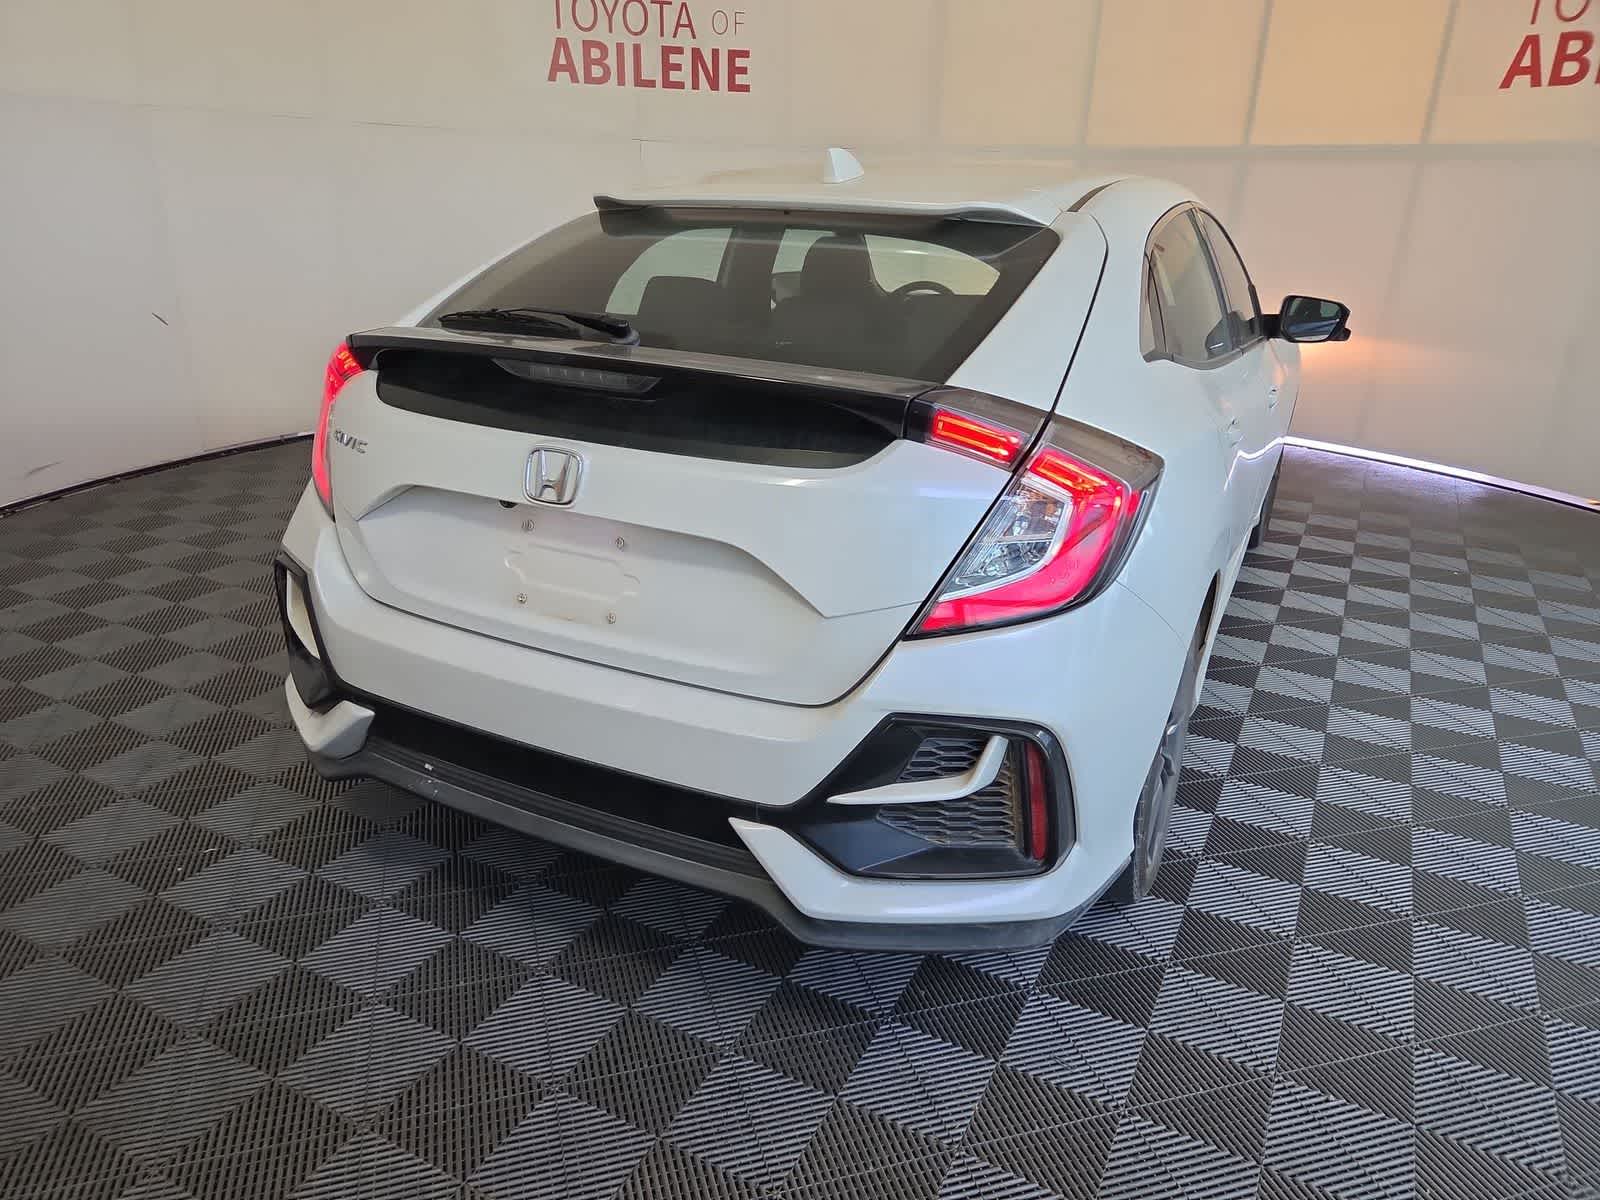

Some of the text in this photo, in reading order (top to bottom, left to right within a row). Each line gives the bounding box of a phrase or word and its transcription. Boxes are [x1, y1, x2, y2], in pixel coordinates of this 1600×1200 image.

[712, 9, 745, 35] OF
[547, 37, 751, 93] ABILENE
[1498, 31, 1600, 89] AB
[333, 429, 368, 454] CIVIC
